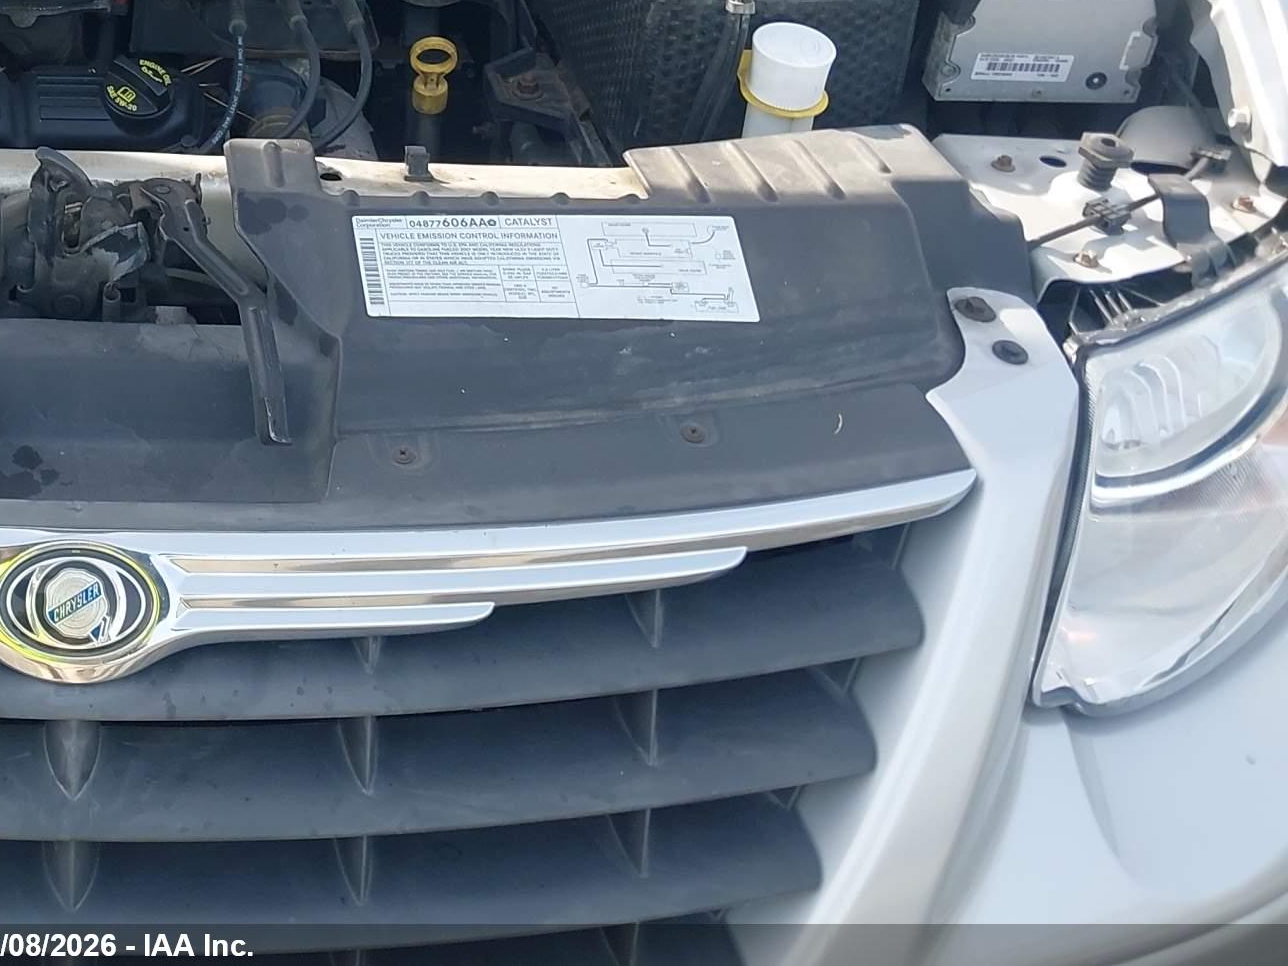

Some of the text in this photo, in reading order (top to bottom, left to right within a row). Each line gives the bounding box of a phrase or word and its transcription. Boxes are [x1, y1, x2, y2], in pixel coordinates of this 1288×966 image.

[139, 59, 172, 86] ENGINE OIL
[106, 85, 138, 112] SAE 5W-20
[380, 232, 558, 240] VEHICLE EMISSION CONTROL INFORMATION
[504, 217, 554, 228] CATALYST
[52, 583, 102, 623] CHRYSLER
